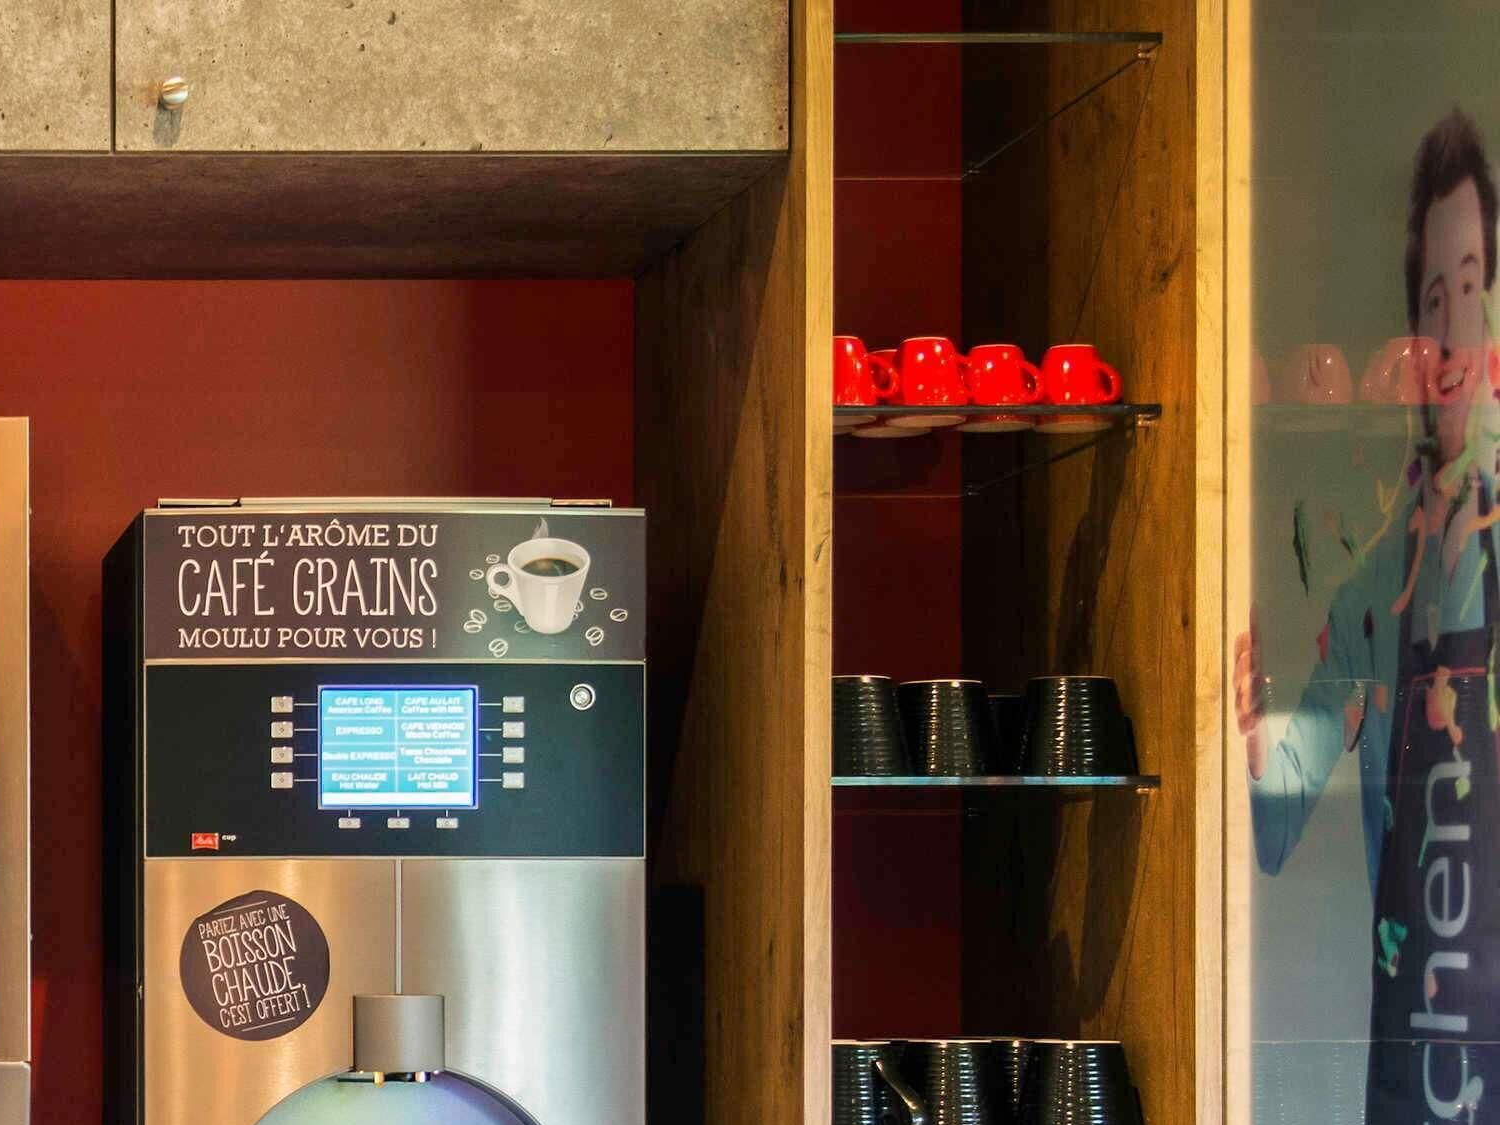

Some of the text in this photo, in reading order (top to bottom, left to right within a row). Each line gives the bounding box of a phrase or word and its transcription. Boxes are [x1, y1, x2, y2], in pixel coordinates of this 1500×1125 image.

[179, 520, 438, 548] TOUT L'ARÔME DU
[178, 551, 438, 616] CAFÉ GRAINS
[179, 628, 270, 649] MOULU
[278, 628, 347, 649] POUR
[353, 628, 423, 649] VOUS
[198, 904, 290, 939] PARTEZ AVEC UNE
[202, 920, 296, 972] BOISSON
[219, 1002, 252, 1028] C'EST
[256, 991, 300, 1020] OFFERT
